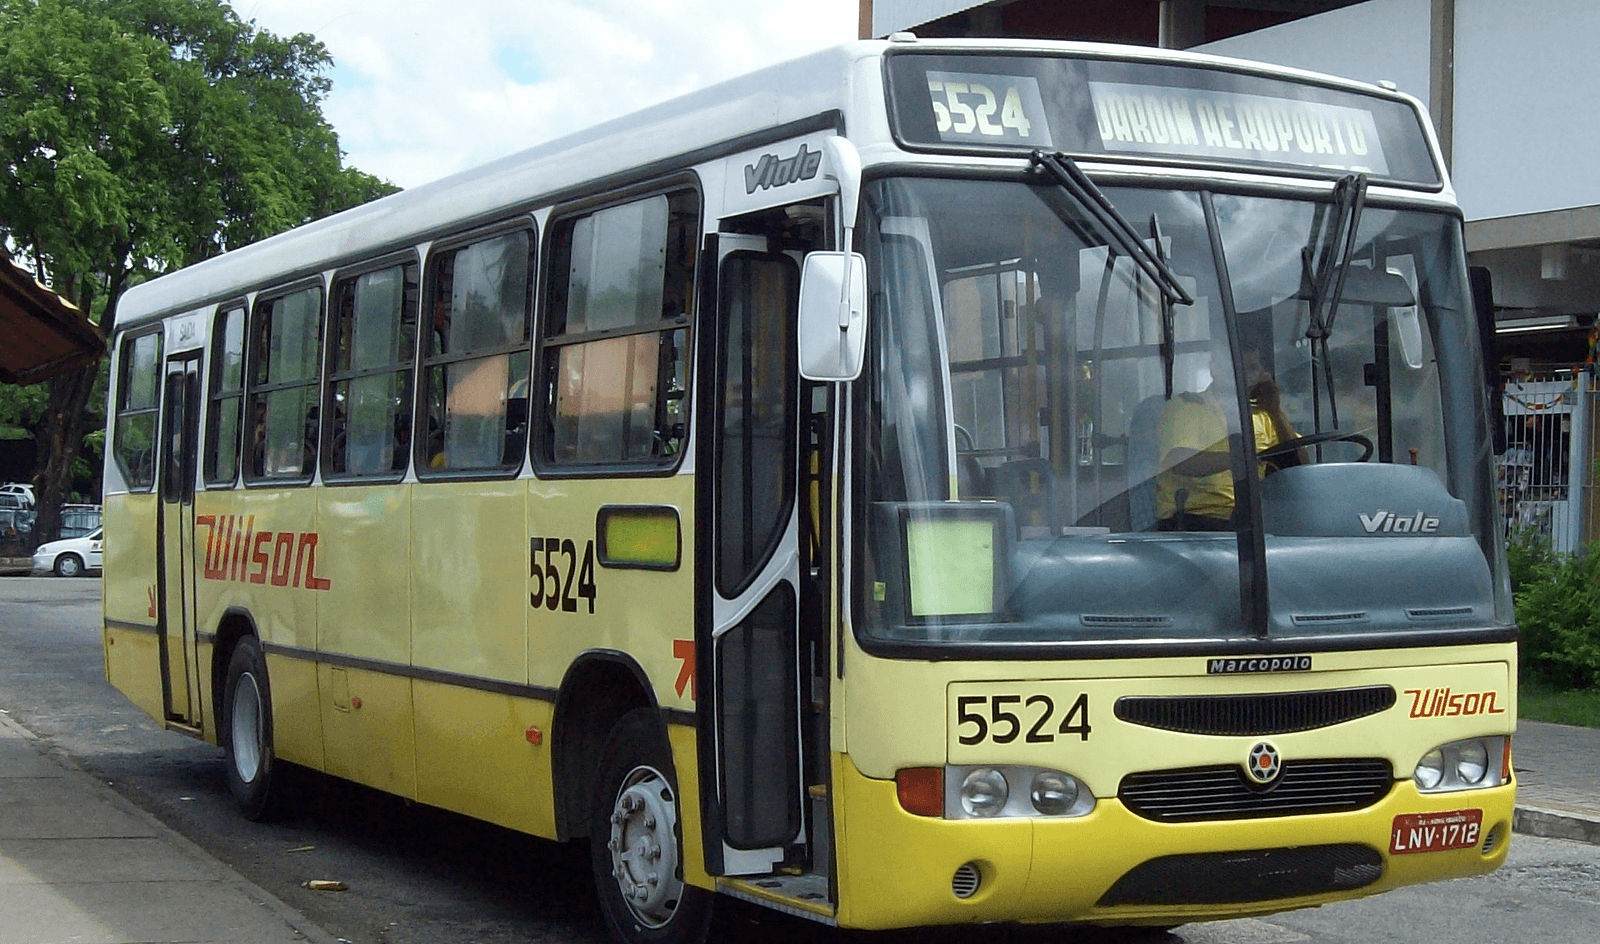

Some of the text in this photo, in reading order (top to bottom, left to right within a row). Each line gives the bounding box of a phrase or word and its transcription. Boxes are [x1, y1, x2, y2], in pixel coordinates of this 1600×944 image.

[928, 81, 1031, 137] 5524
[1196, 98, 1368, 156] AEROPORTO
[744, 143, 822, 195] Viale
[1358, 510, 1440, 533] Viale
[196, 514, 332, 591] Wilson
[530, 537, 597, 614] 5524
[1210, 657, 1311, 674] Marcopolo
[957, 693, 1092, 746] 5524
[1403, 687, 1505, 719] Wilson
